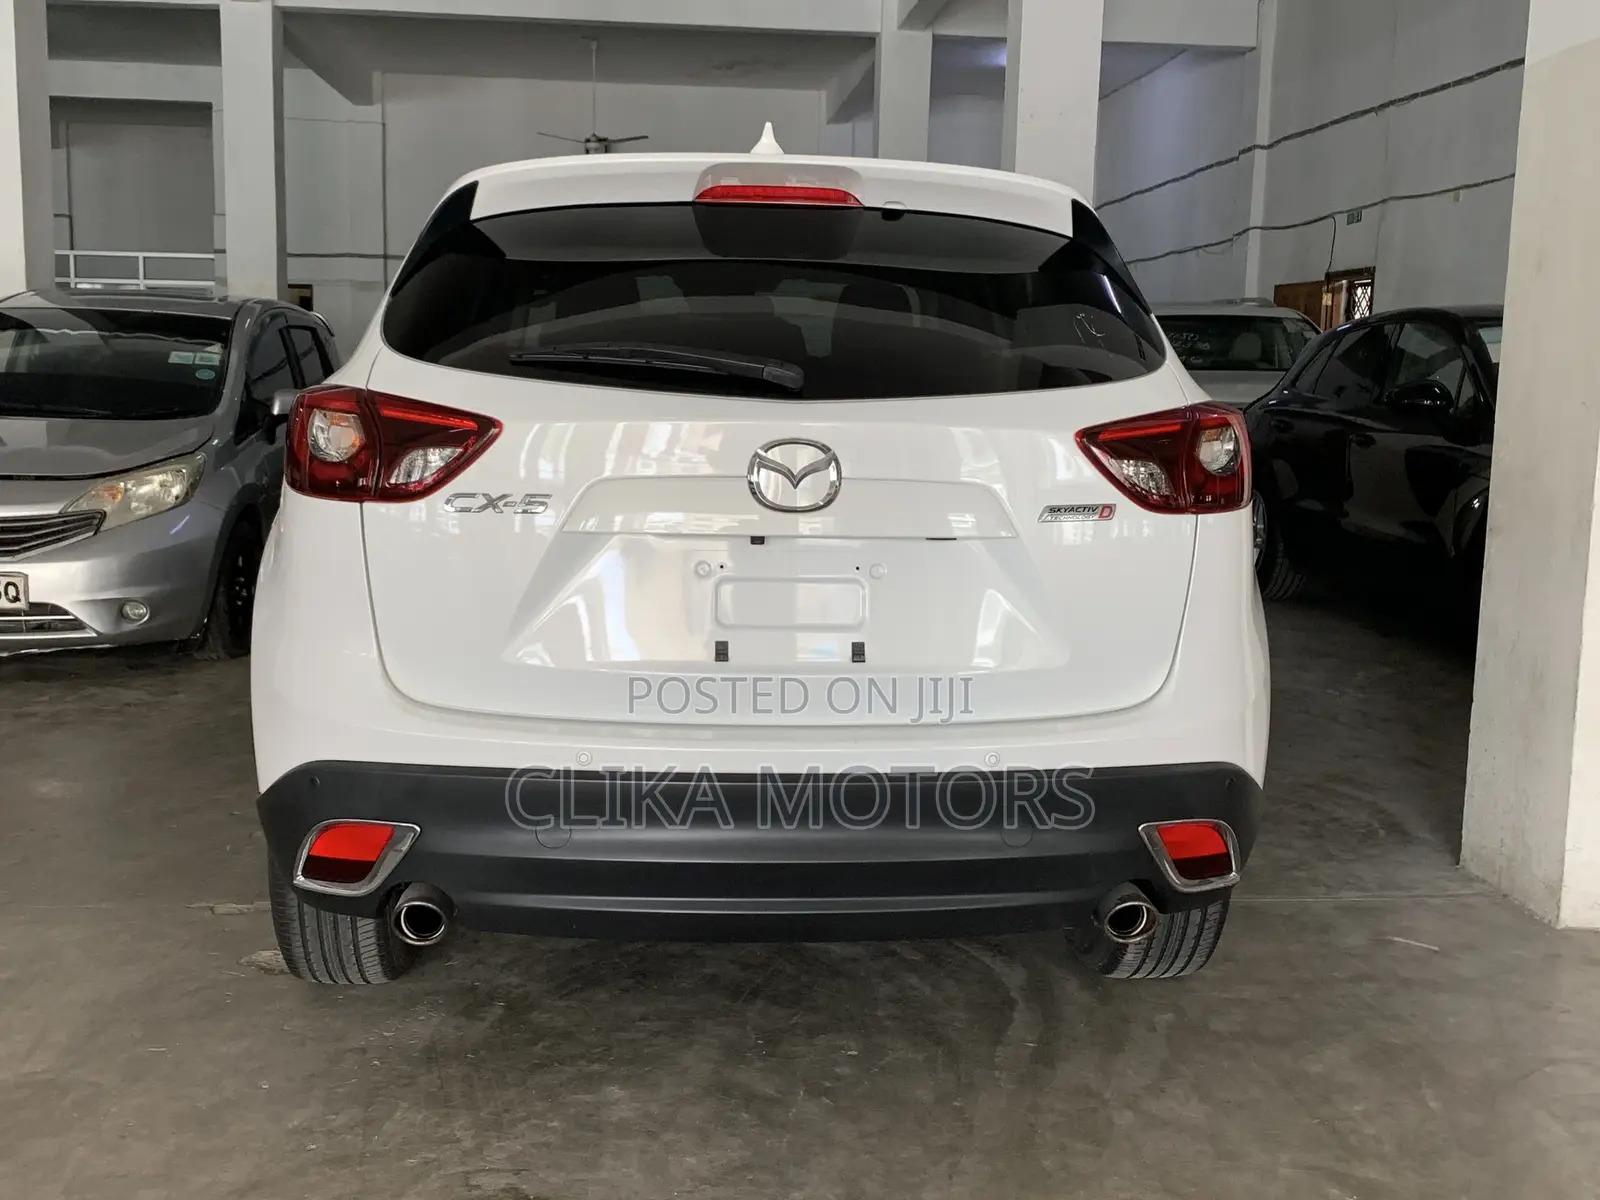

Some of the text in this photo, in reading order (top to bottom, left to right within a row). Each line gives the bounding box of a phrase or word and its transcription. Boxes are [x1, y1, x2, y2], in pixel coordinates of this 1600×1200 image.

[443, 492, 553, 514] CX-5
[1047, 505, 1114, 519] SKYACTIV D
[0, 581, 21, 604] Q
